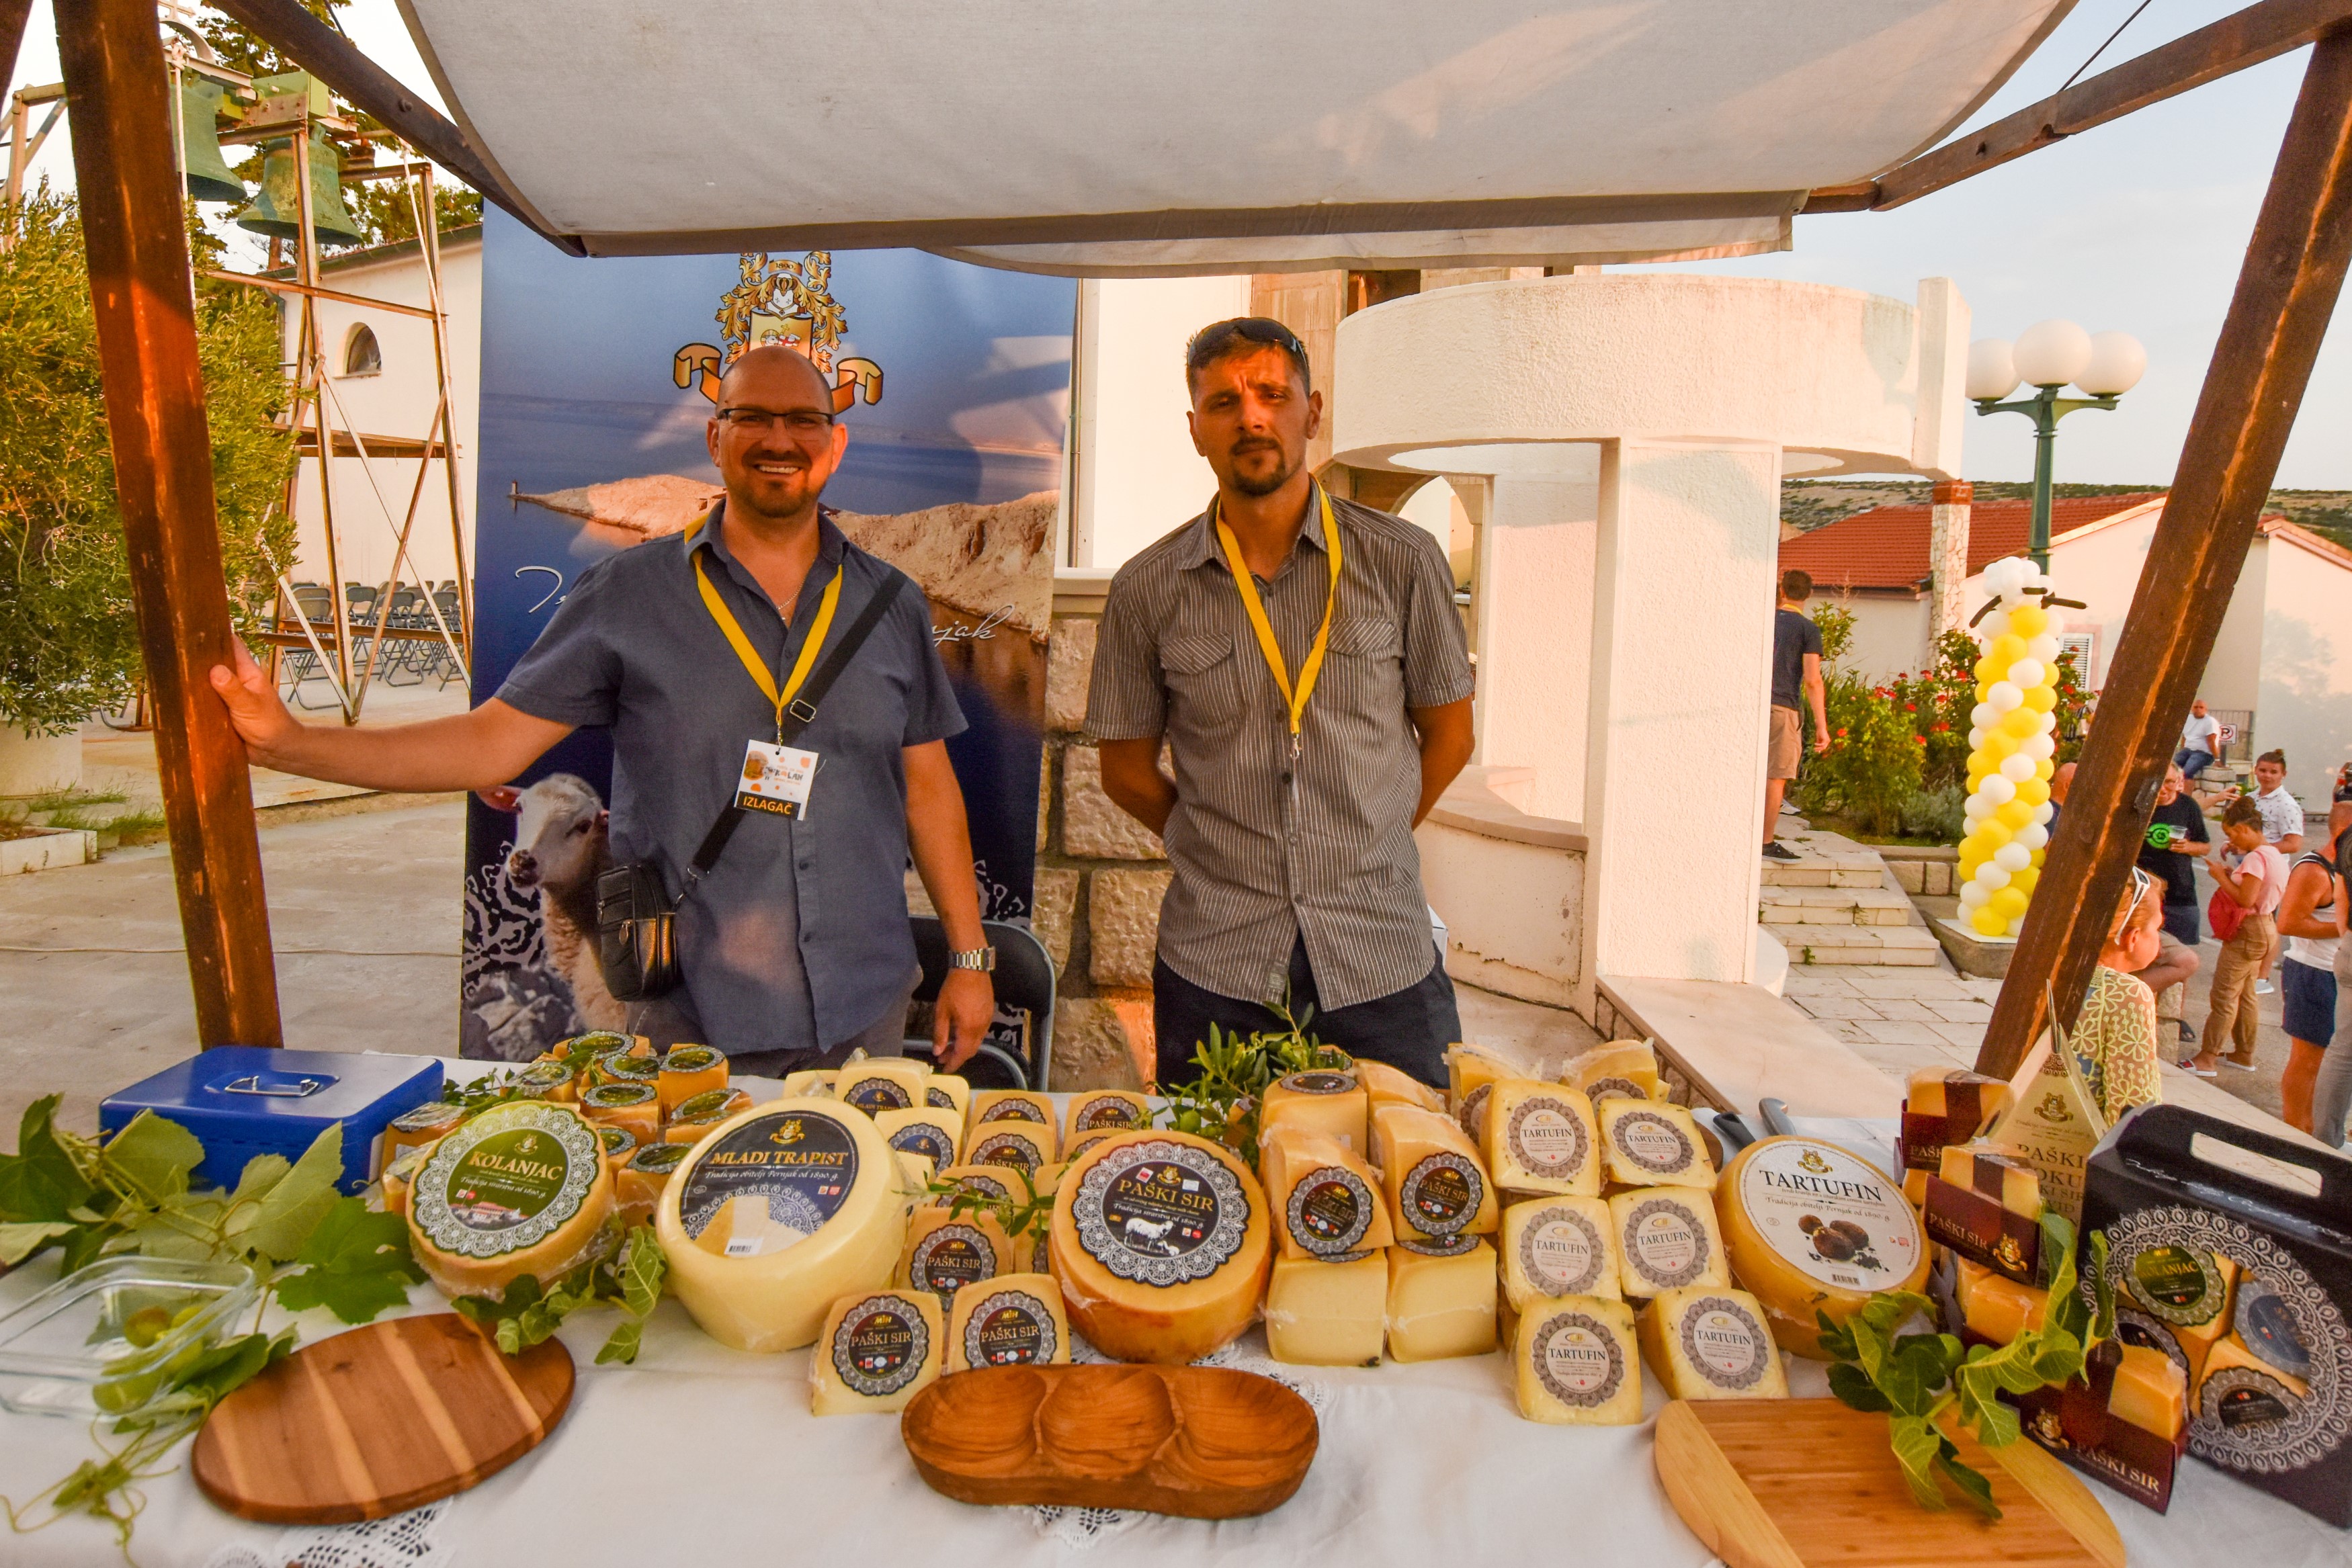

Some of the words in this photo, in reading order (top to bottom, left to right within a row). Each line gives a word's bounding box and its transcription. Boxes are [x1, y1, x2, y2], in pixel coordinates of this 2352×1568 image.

[775, 262, 796, 270] 1890.
[743, 796, 793, 815] IZLAGAČ
[1089, 1119, 1115, 1128] PAŠKI
[1521, 1129, 1572, 1137] TARTUFIN
[1627, 1135, 1676, 1143] TARTUFIN
[468, 1151, 563, 1180] KOLANJAC
[709, 1151, 771, 1165] MLADI
[773, 1151, 849, 1166] TRAPIST
[984, 1159, 1012, 1168] PAŠKI
[1014, 1163, 1030, 1171] SIR
[705, 1171, 739, 1182] Tradicija
[741, 1171, 766, 1182] obitelji
[767, 1171, 798, 1182] Pernjak
[1419, 1180, 1451, 1196] PAŠKI
[1452, 1189, 1469, 1202] SIR
[1759, 1170, 1882, 1202] TARTUFIN
[1118, 1178, 1179, 1203] PAŠKI
[1181, 1193, 1214, 1212] SIR
[1114, 1203, 1142, 1214] Tradicija
[1143, 1209, 1171, 1220] sirarstva
[1765, 1196, 1798, 1209] Tradicija
[1800, 1202, 1824, 1212] obitelji
[1825, 1205, 1852, 1215] Pernjak
[1638, 1231, 1691, 1245] TARTUFIN
[1929, 1213, 1966, 1239] PAŠKI
[1967, 1231, 1988, 1250] SIR
[1535, 1239, 1588, 1255] TARTUFIN
[927, 1256, 960, 1268] PAŠKI
[962, 1258, 980, 1269] SIR
[851, 1332, 888, 1347] PAŠKI
[891, 1332, 911, 1343] SIR
[981, 1327, 1017, 1342] PAŠKI
[1019, 1325, 1040, 1338] SIR
[1696, 1330, 1750, 1345] TARTUFIN
[1548, 1348, 1605, 1360] TARTUFIN
[2130, 1467, 2159, 1493] SIR
